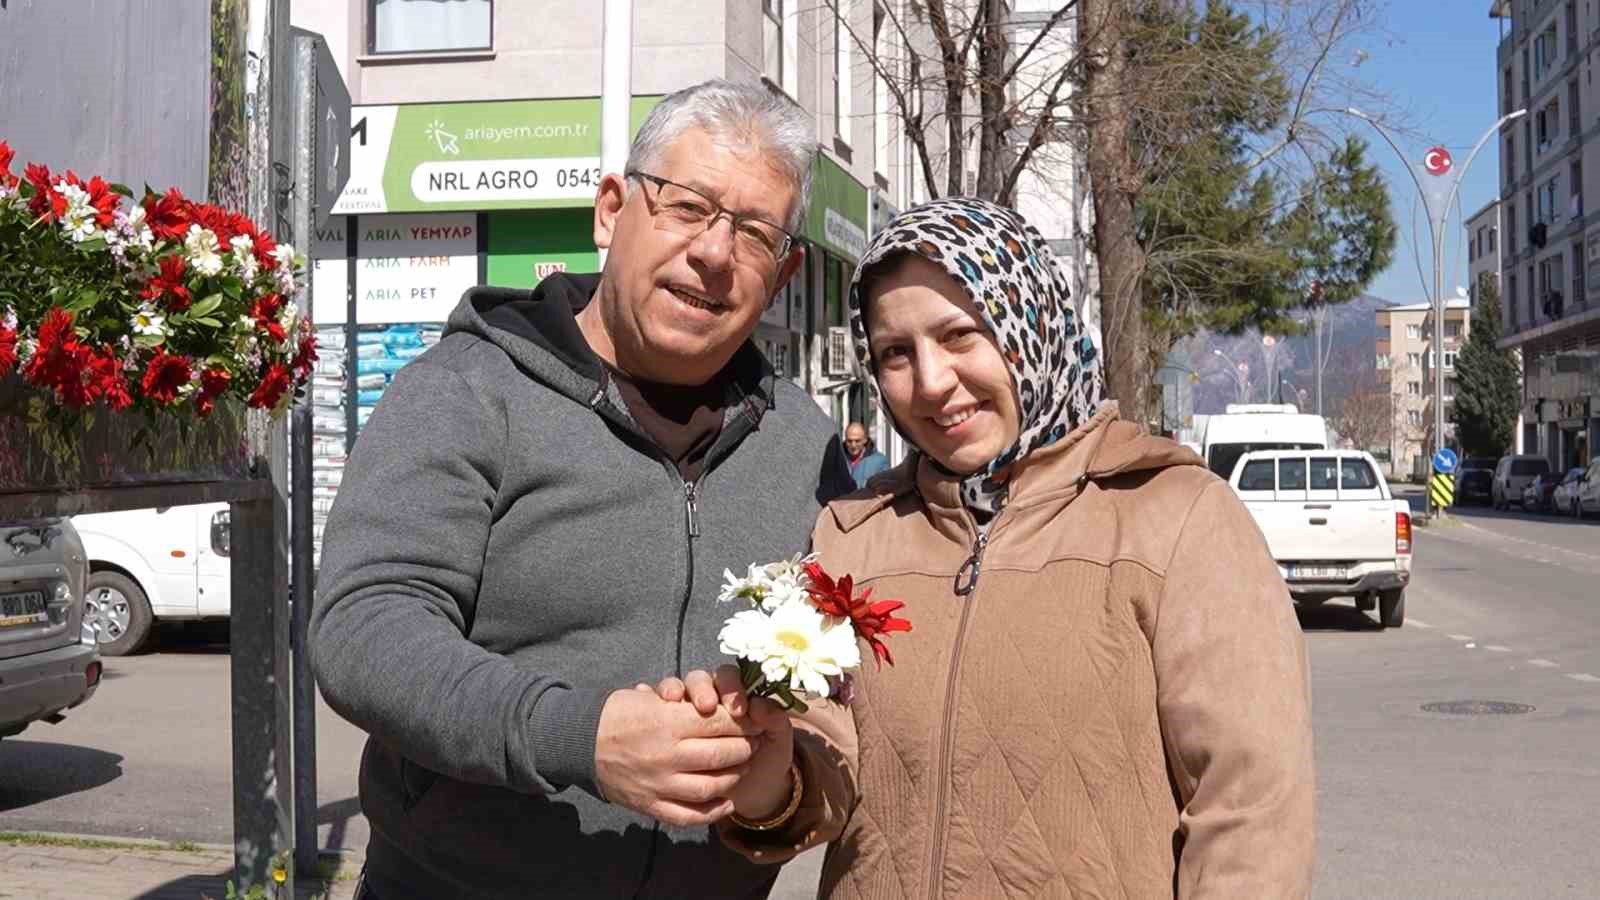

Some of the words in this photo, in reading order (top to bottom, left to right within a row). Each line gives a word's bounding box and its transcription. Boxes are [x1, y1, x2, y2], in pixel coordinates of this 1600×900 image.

[464, 123, 589, 142] ariayem.com.tr
[429, 171, 470, 191] NRL
[476, 170, 538, 190] AGRO
[556, 168, 600, 188] 0543
[366, 229, 401, 241] ARIA
[410, 226, 473, 240] YEMYAP
[366, 256, 401, 268] ARIA
[410, 255, 450, 267] FARM
[366, 288, 401, 300] ARIA
[411, 287, 437, 299] PET
